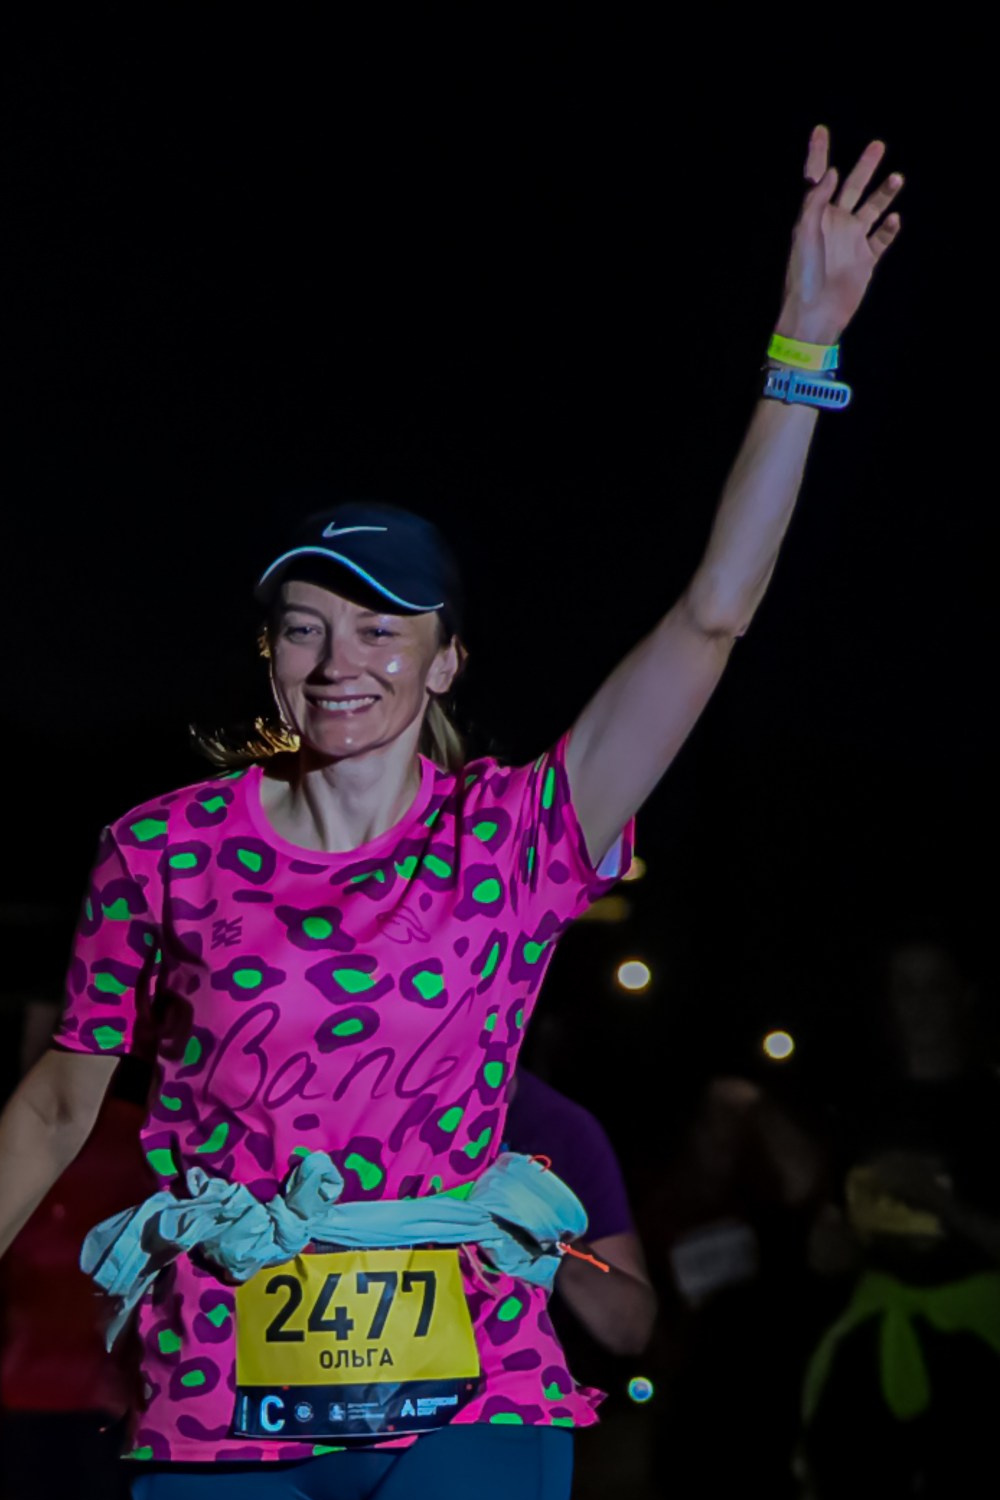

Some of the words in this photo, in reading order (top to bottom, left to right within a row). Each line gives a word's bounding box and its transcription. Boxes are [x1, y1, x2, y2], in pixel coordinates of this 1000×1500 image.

[265, 1270, 436, 1343] 2477
[319, 1348, 394, 1370] ОЛЬГА
[260, 1395, 286, 1432] C
